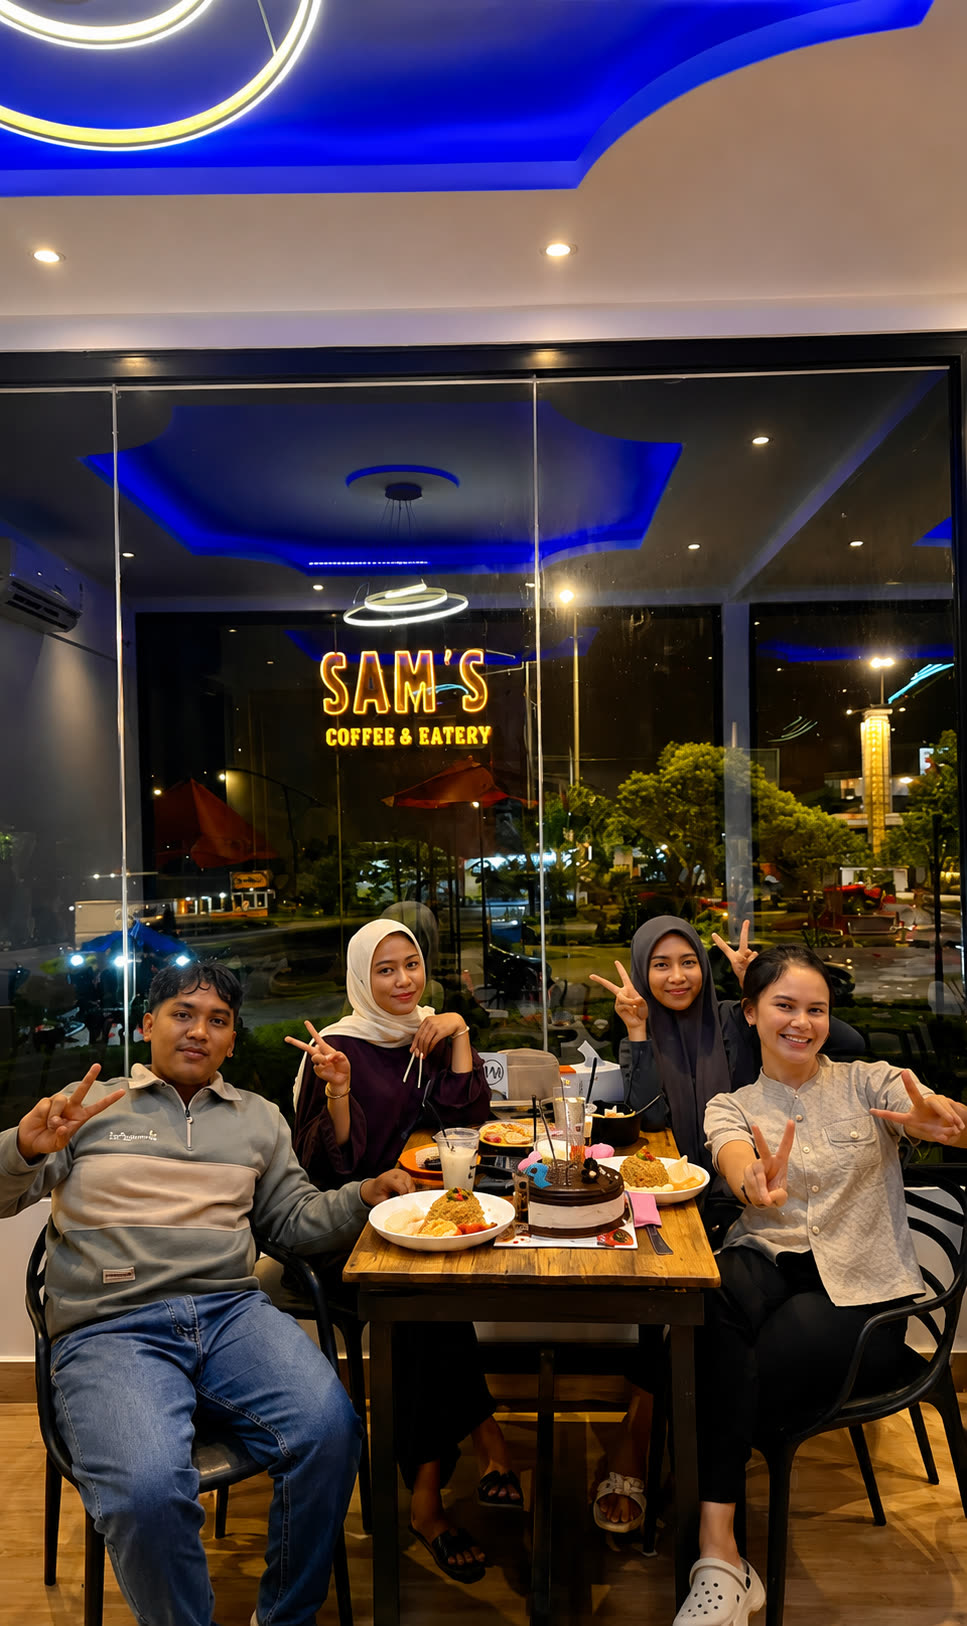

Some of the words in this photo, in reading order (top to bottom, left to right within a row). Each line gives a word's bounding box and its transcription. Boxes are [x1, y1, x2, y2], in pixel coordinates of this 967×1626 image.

[320, 649, 488, 714] SAM'S
[325, 727, 395, 746] COFFEE
[399, 727, 413, 745] &
[418, 725, 492, 745] EATERY
